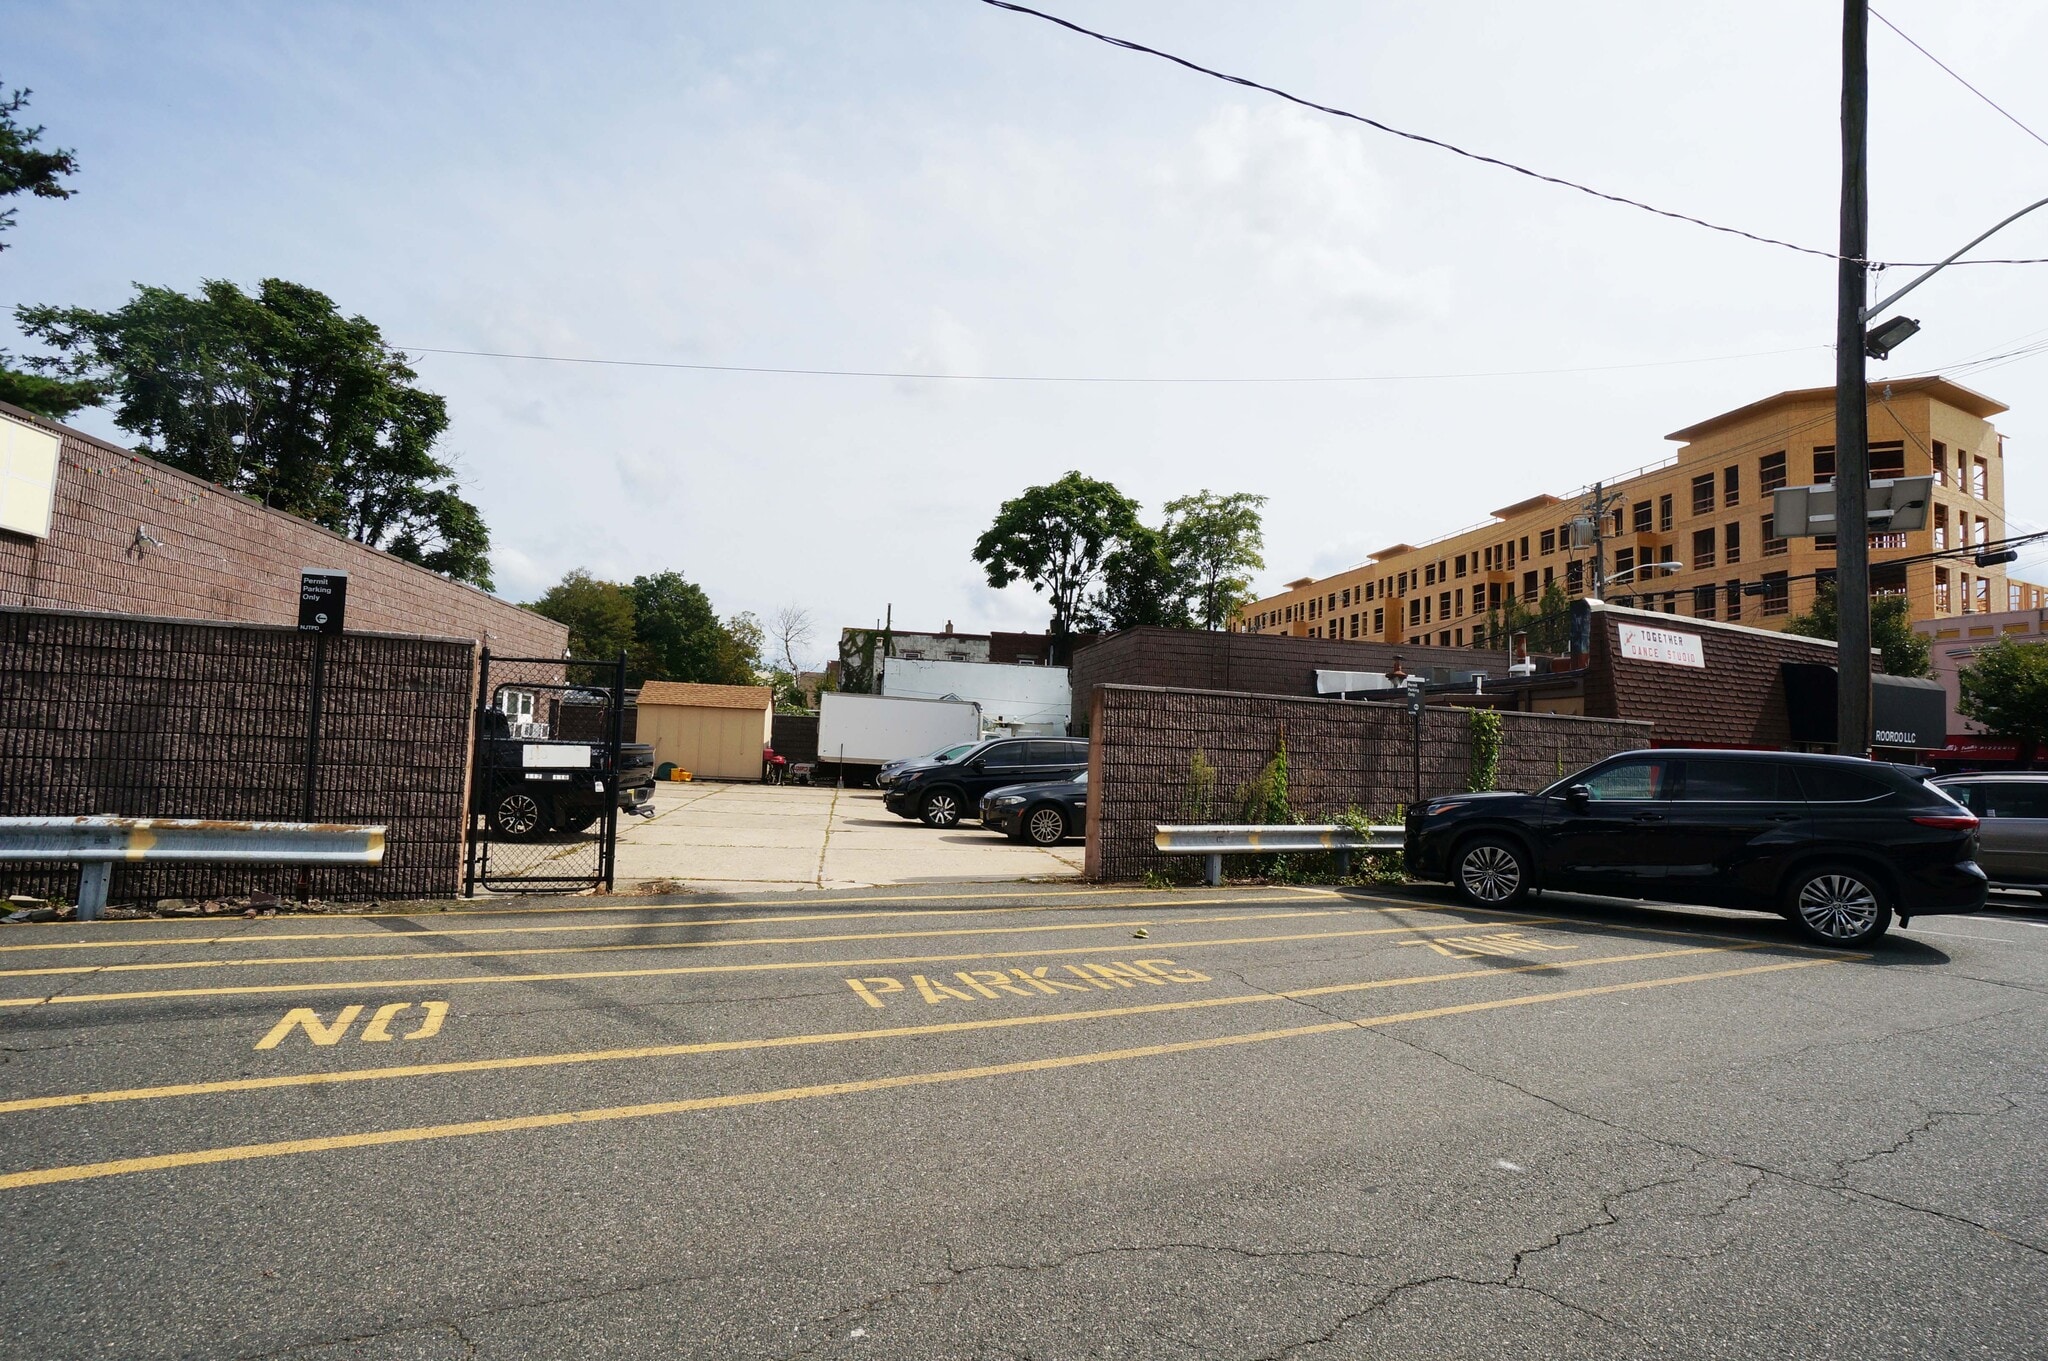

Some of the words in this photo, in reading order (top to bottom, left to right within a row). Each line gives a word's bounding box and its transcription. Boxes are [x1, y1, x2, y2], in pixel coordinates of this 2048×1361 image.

[303, 577, 328, 585] Permit
[302, 585, 332, 594] Parking
[302, 593, 320, 601] Only
[1641, 630, 1683, 646] TOGETHER
[1632, 645, 1659, 658] DANCE
[1667, 649, 1696, 663] STUDIO
[1875, 730, 1904, 743] ROOROO
[1904, 732, 1916, 743] LLC
[253, 1001, 450, 1050] NO
[845, 959, 1212, 1008] PARKING
